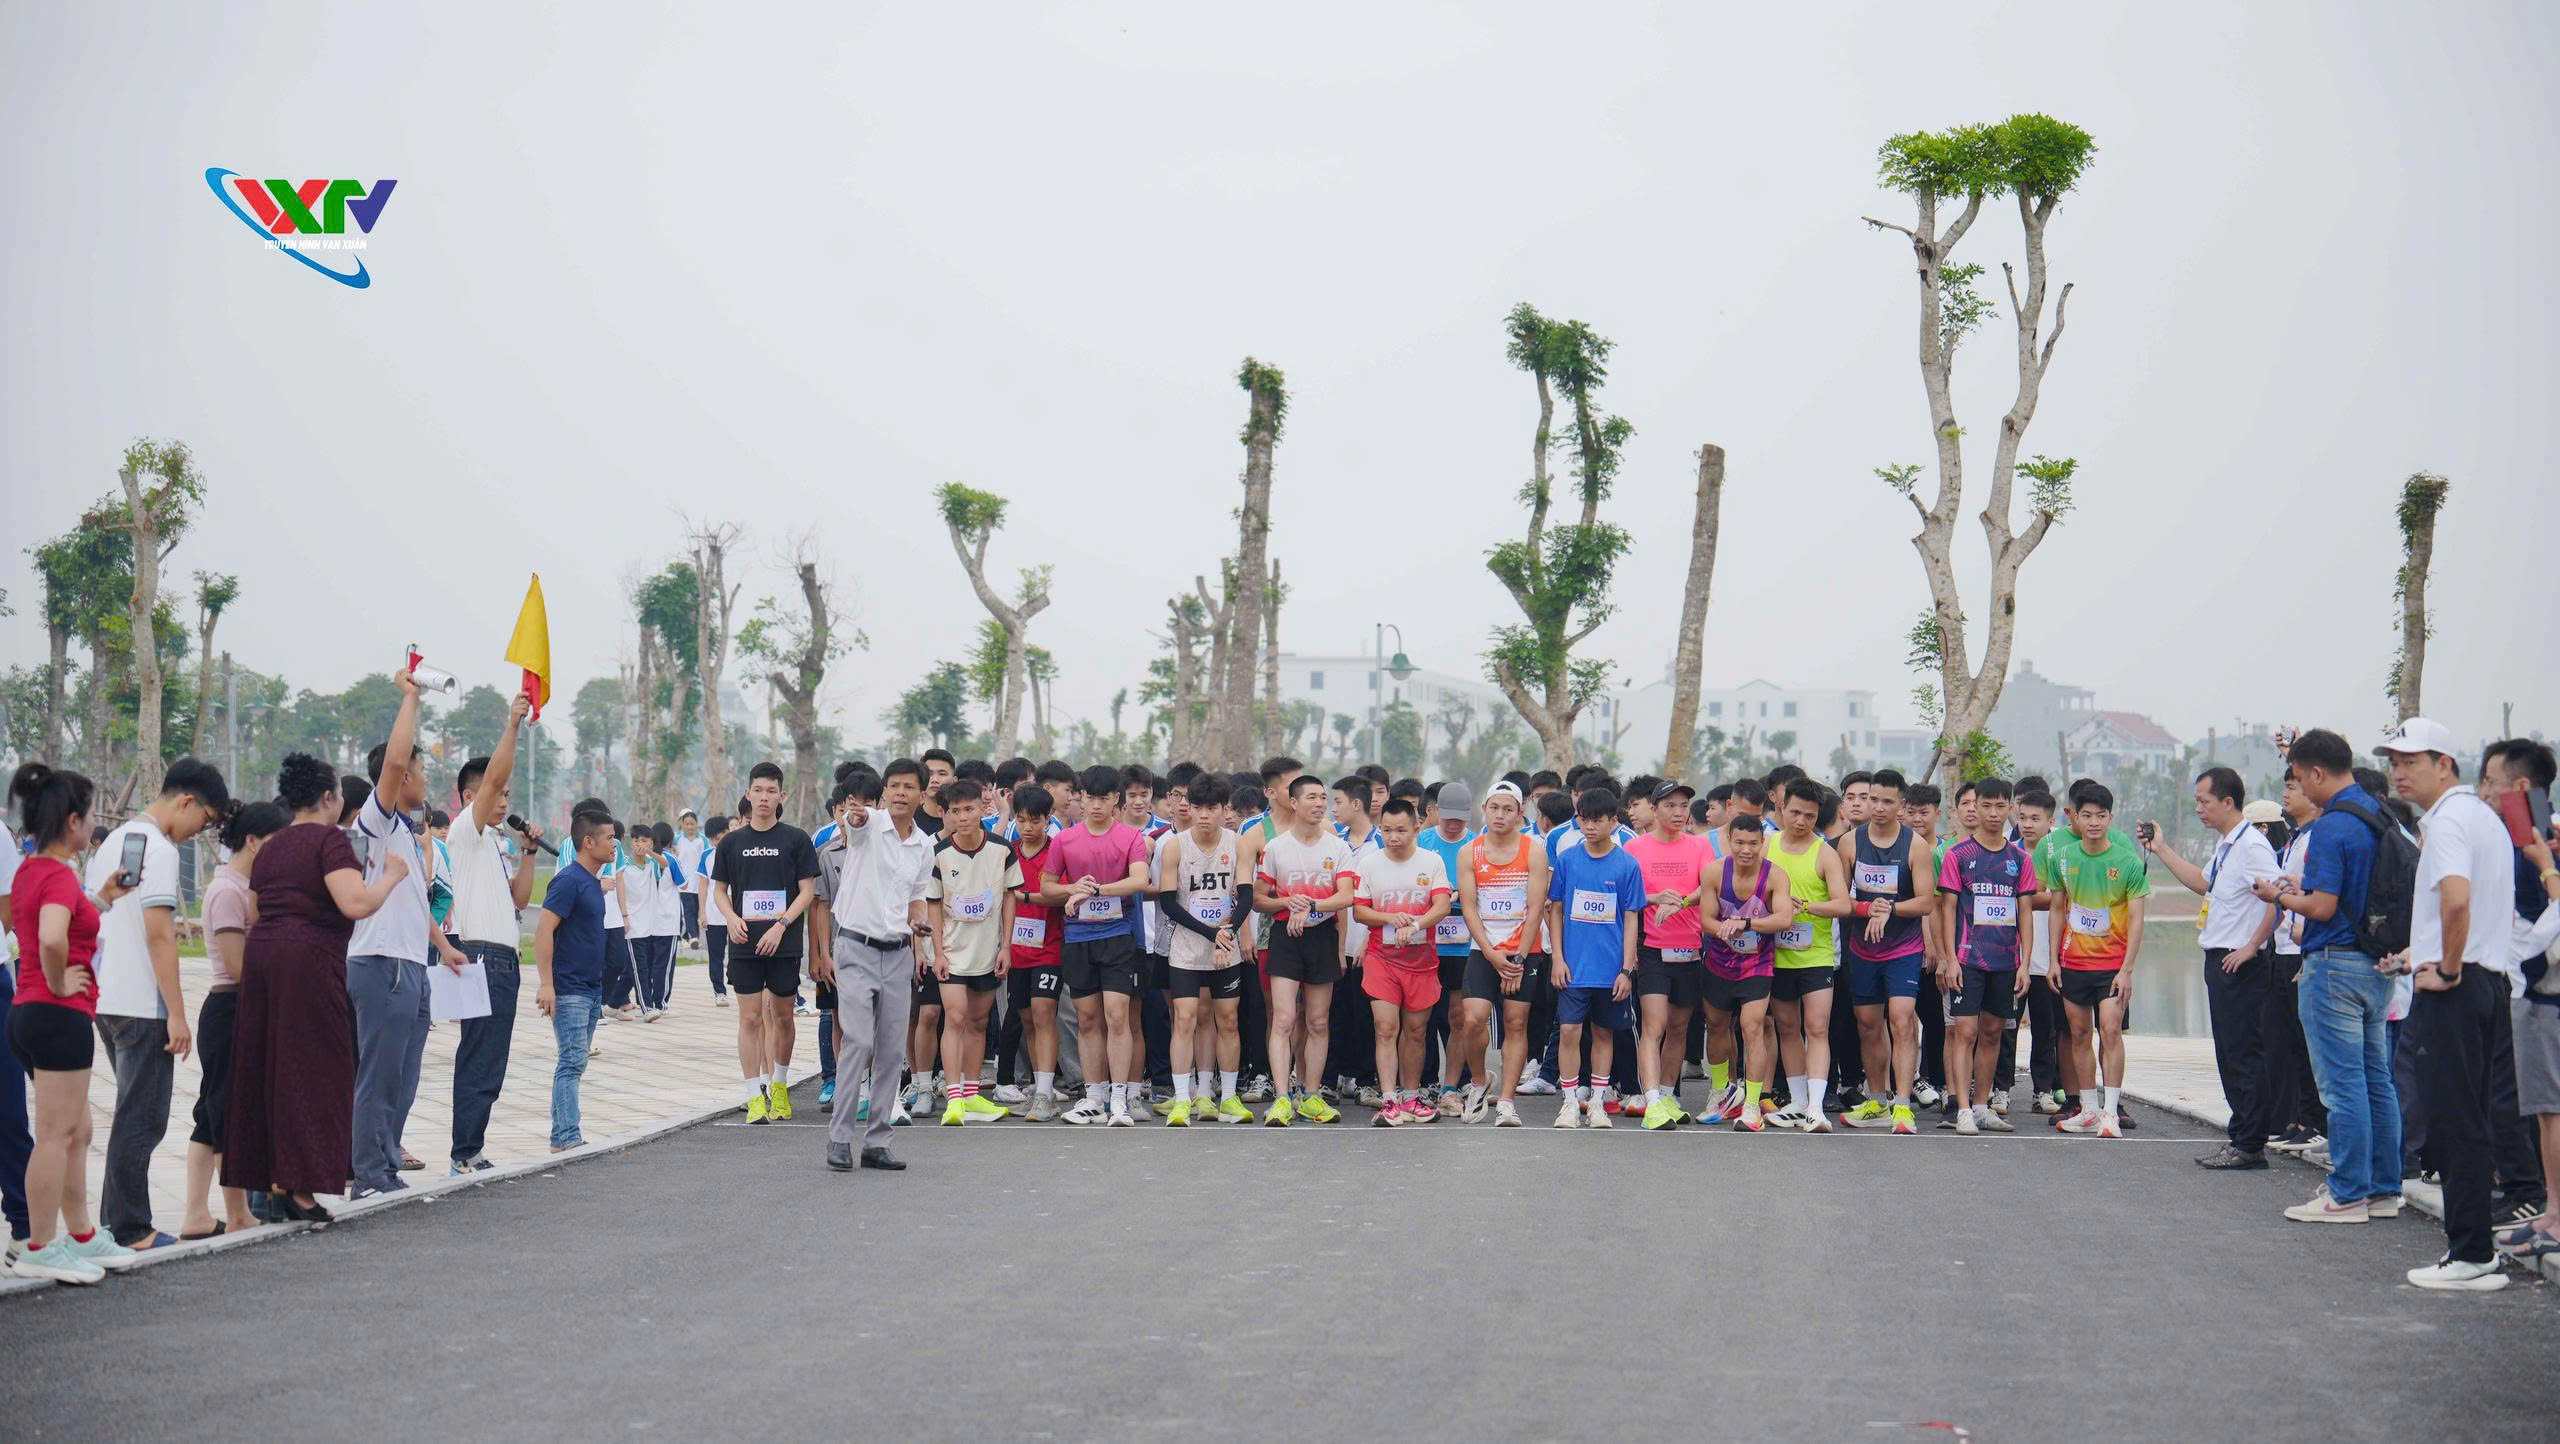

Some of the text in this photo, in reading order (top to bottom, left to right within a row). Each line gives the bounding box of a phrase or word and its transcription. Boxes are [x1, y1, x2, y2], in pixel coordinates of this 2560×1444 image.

[742, 846, 779, 857] adidas
[1189, 872, 1230, 891] LBT
[1287, 871, 1332, 887] PYR
[1864, 873, 1886, 884] 043
[1380, 889, 1426, 907] PYR
[753, 900, 775, 911] 089
[964, 902, 985, 914] 088
[1090, 900, 1110, 911] 029
[1490, 900, 1512, 911] 079
[1583, 900, 1605, 912] 090
[1201, 908, 1222, 919] 026
[1986, 906, 2007, 917] 092
[2081, 915, 2098, 928] 007
[1017, 926, 1034, 939] 076
[1437, 925, 1458, 935] 068
[1780, 931, 1800, 942] 021
[1731, 939, 1745, 948] 78
[1038, 973, 1058, 991] 27
